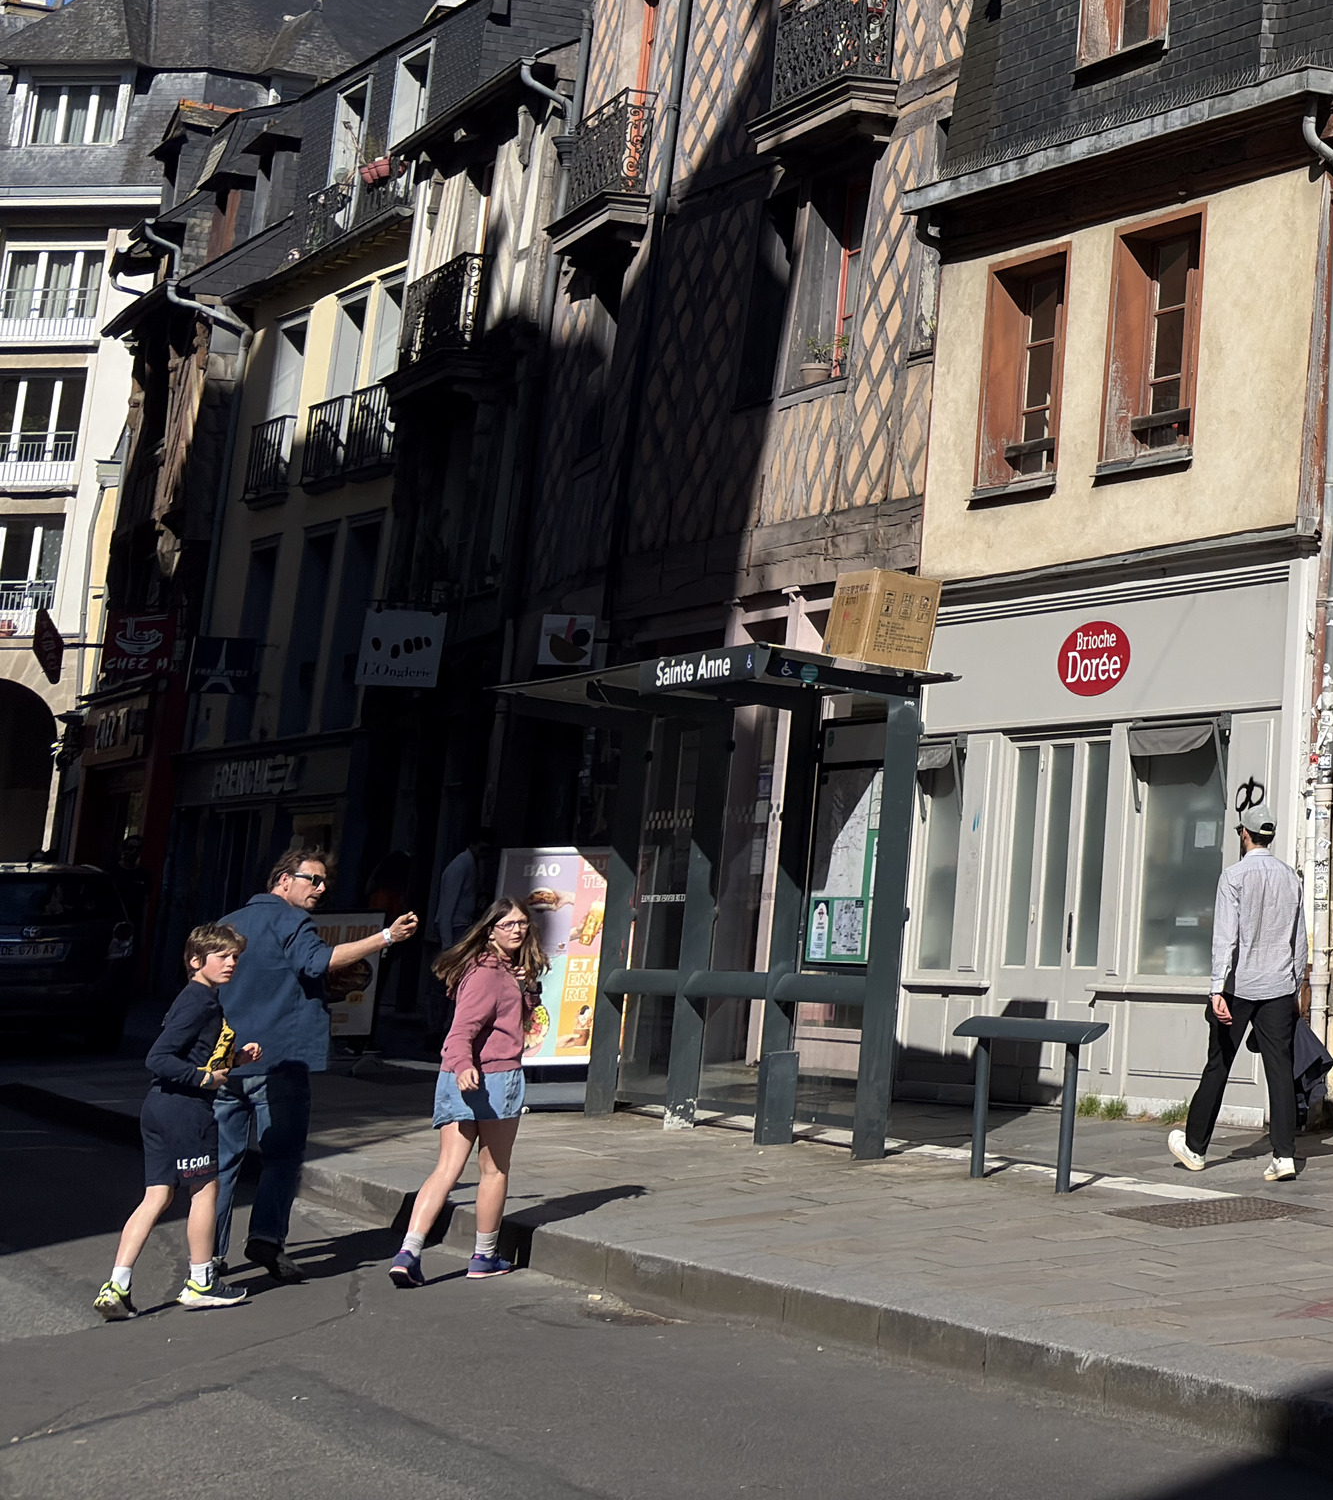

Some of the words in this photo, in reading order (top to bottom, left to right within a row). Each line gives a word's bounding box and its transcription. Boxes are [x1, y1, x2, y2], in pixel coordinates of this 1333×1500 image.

[1075, 629, 1117, 651] Brioche
[104, 656, 150, 670] CHEZ
[1065, 652, 1121, 683] Dorée
[655, 658, 694, 687] Sainte
[696, 654, 731, 681] Anne
[523, 863, 562, 877] BAO
[568, 958, 591, 972] ET
[564, 987, 589, 1002] RE
[176, 1158, 188, 1170] LE
